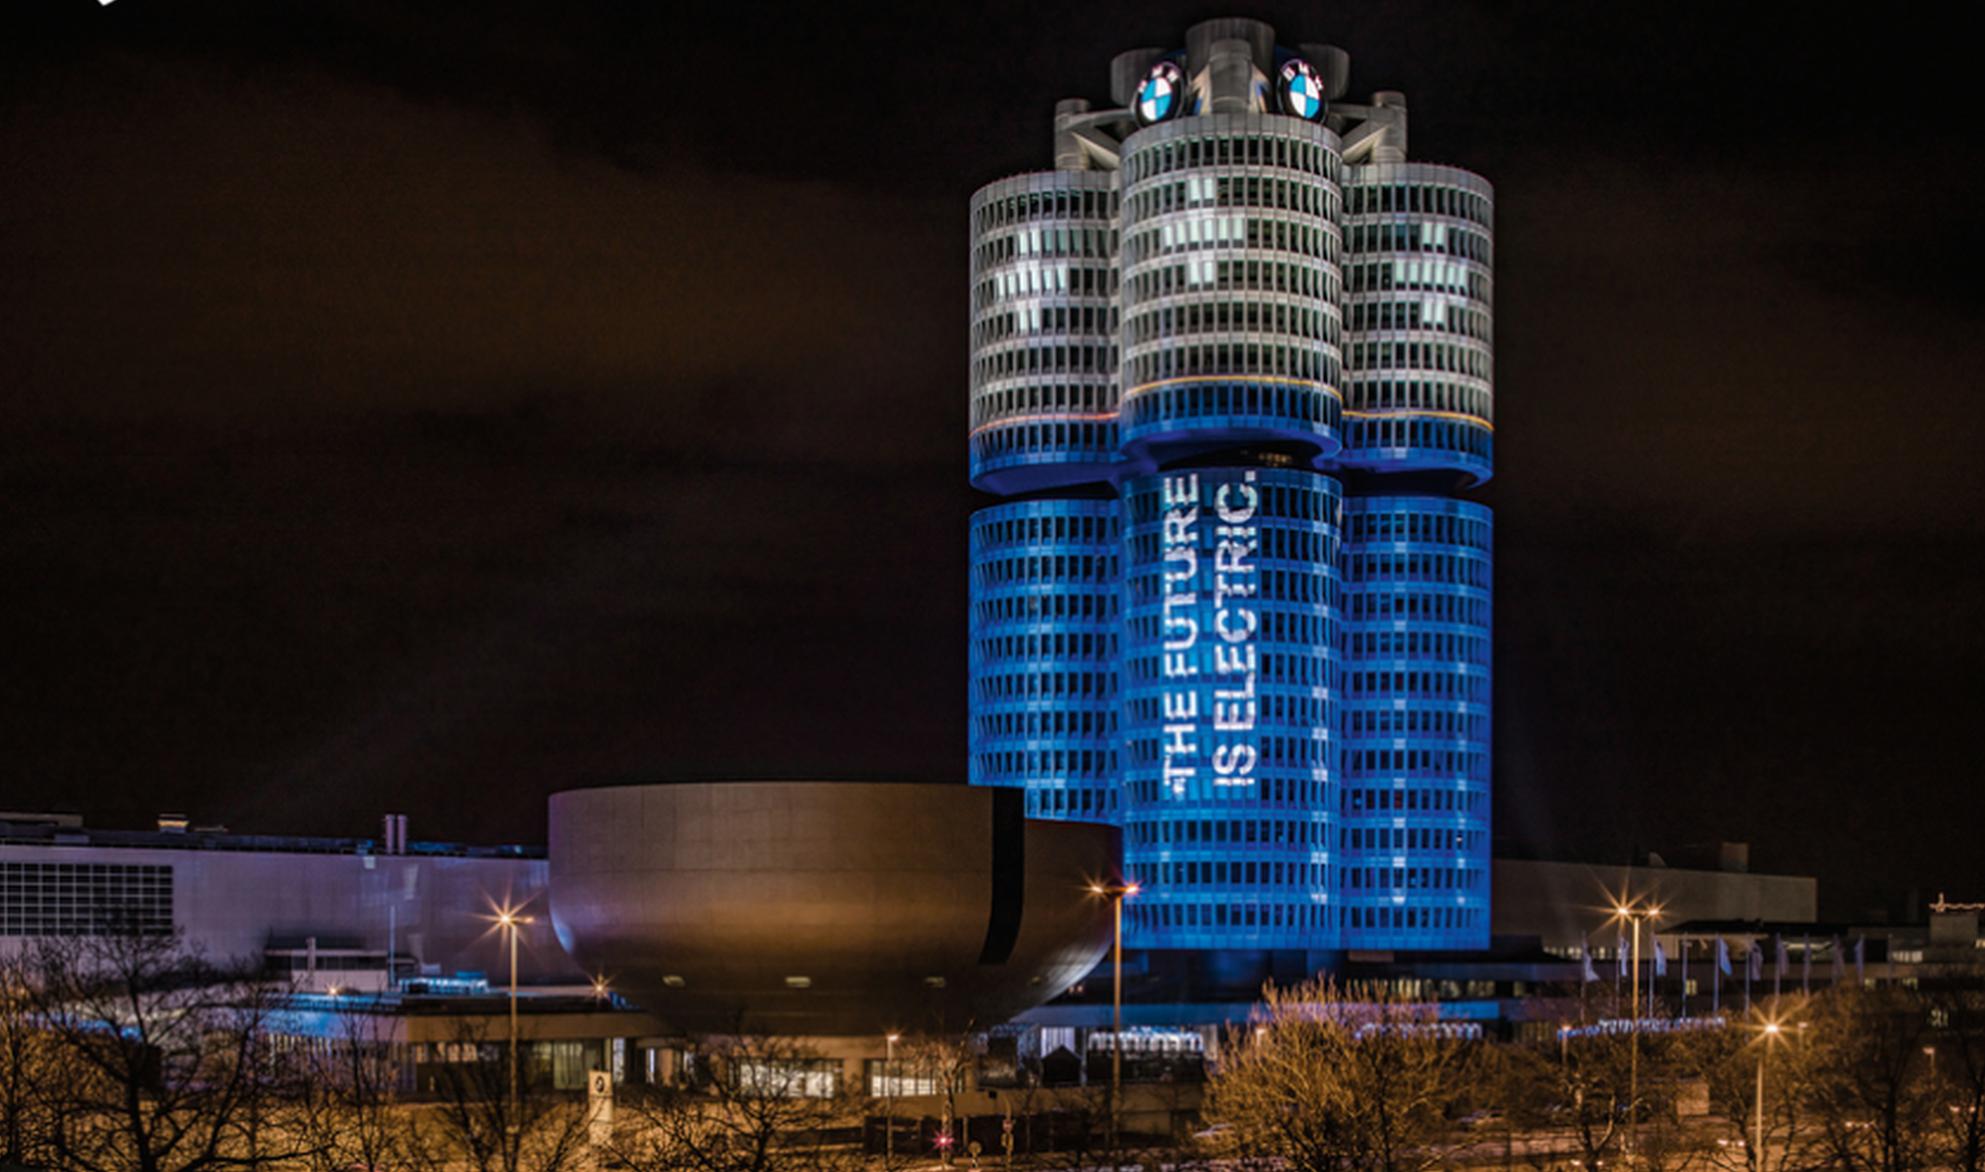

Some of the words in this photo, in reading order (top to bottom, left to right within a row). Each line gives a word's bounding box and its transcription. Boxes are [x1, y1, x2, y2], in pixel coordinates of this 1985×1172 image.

[1163, 473, 1198, 678] FUTURE
[1213, 470, 1258, 730] ELECTRIC.
[1163, 690, 1197, 786] THE
[1212, 744, 1256, 787] IS
